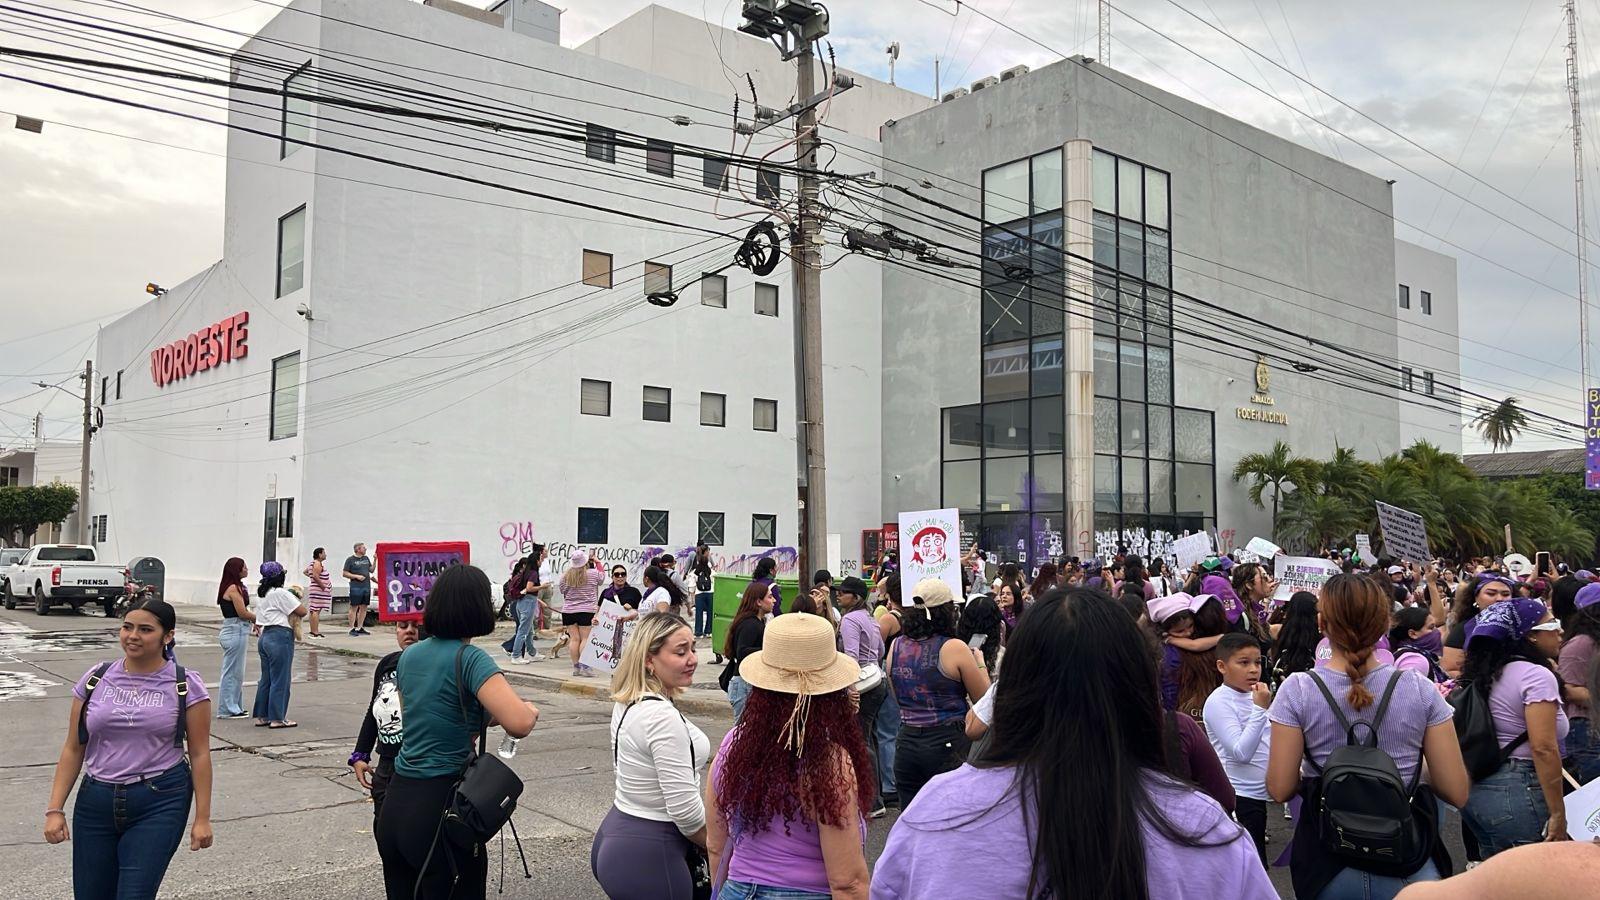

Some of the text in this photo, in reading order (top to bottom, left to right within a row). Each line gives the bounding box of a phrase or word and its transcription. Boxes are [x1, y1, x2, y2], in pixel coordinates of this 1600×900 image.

[151, 311, 249, 388] NOROESTE
[499, 521, 534, 557] 8M
[905, 520, 922, 537] HAZLE
[521, 540, 532, 554] E
[594, 546, 647, 565] ONCORDIA
[926, 557, 952, 575] ABUSADOR
[100, 685, 165, 707] PUMA
